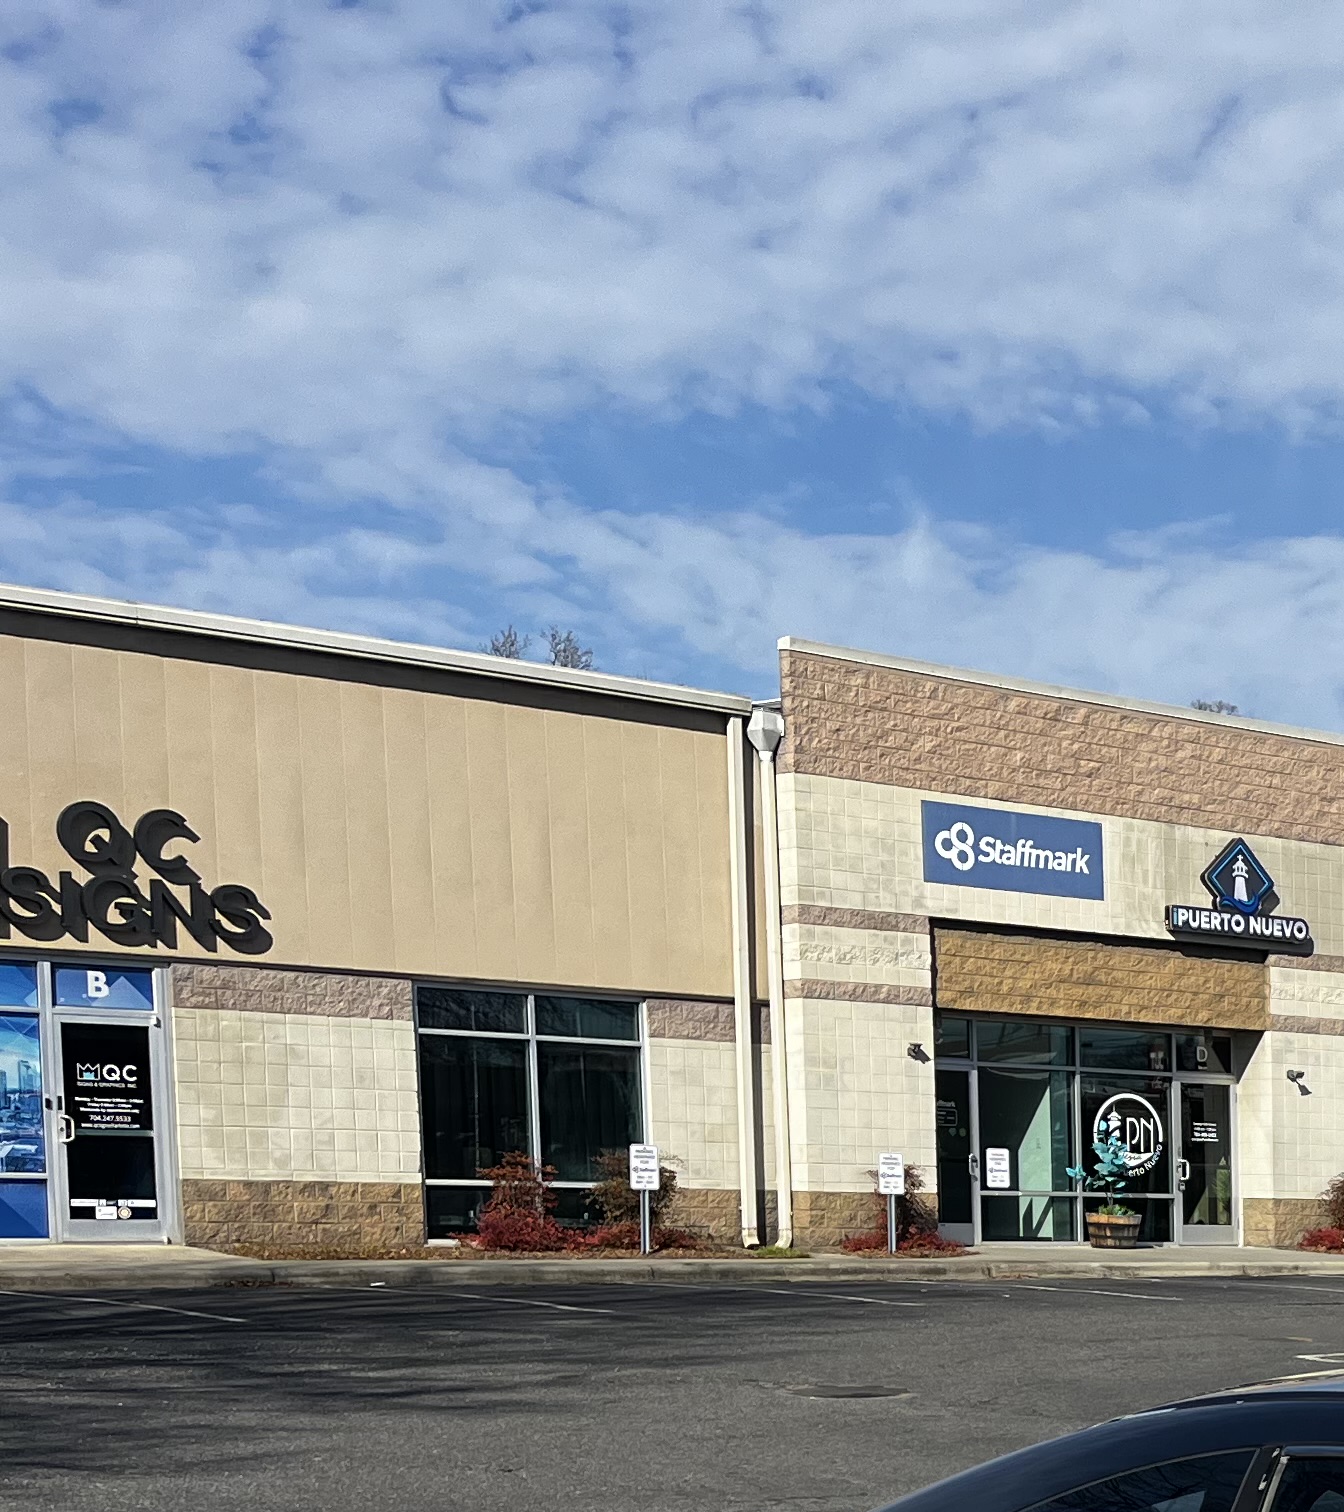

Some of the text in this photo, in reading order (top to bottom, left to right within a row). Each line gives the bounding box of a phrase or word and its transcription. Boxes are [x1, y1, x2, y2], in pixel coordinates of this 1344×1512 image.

[56, 800, 200, 880] QC
[977, 835, 1091, 875] Staffmark
[0, 866, 268, 953] SIGNS
[1249, 915, 1308, 940] NUEVO
[86, 970, 110, 998] B
[1196, 1046, 1208, 1062] D
[102, 1064, 138, 1082] QC
[1126, 1116, 1154, 1153] PN
